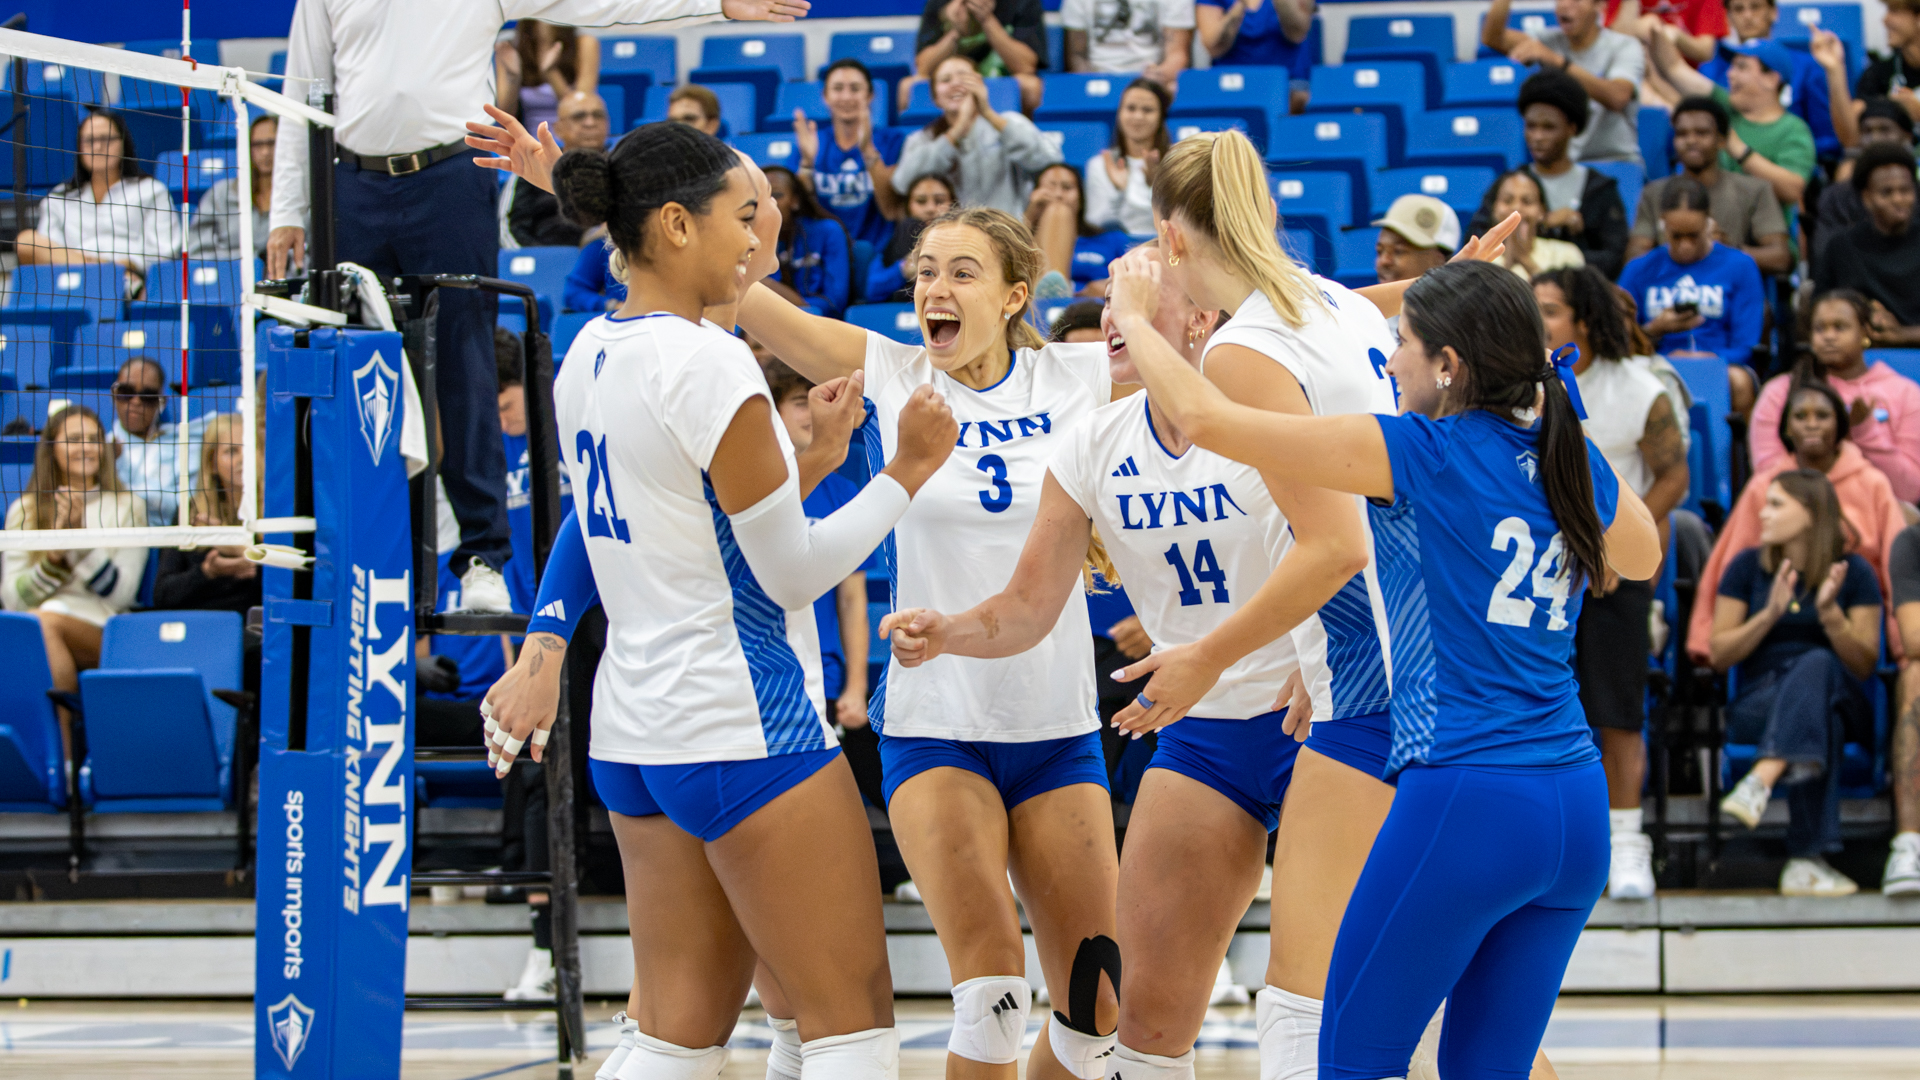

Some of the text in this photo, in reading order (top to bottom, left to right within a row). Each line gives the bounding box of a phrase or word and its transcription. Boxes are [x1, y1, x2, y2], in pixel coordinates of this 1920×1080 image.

[576, 429, 632, 544] 21
[954, 412, 1052, 449] YNN
[976, 453, 1013, 514] 3
[1163, 538, 1230, 607] 14
[1486, 516, 1571, 631] 24
[343, 563, 366, 916] FIGHTING KNIGHTS
[363, 568, 410, 913] LYNN
[281, 789, 306, 980] sports imports
